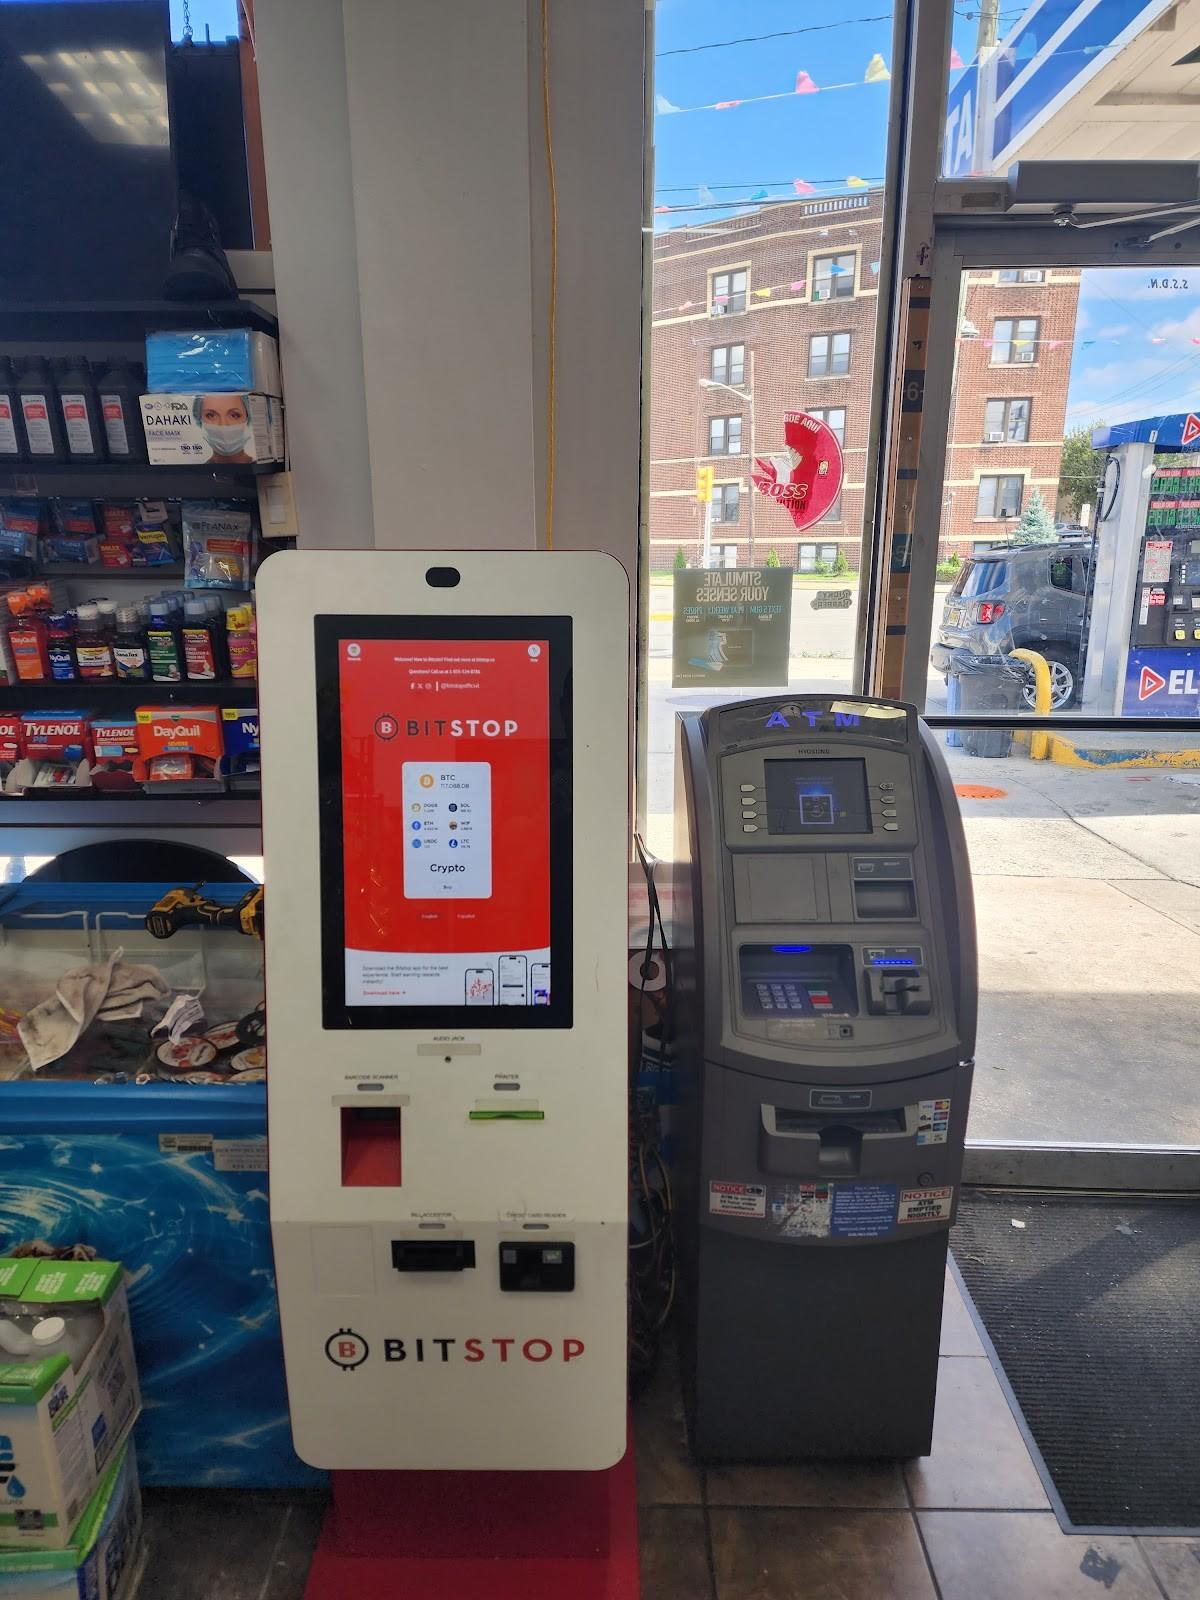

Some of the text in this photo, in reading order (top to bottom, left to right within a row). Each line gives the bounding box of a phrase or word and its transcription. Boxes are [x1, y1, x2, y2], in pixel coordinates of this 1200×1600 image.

[907, 382, 918, 401] 6
[146, 414, 192, 426] DAHAKI
[757, 481, 808, 499] BOSS
[1168, 669, 1198, 695] EL
[766, 710, 860, 728] ATM
[24, 722, 81, 736] TYLENOL
[96, 728, 135, 737] TYLENOL
[153, 725, 200, 739] DayQuil
[407, 719, 519, 737] BITSTOP
[430, 863, 466, 873] Crypto
[712, 1184, 744, 1194] NOTICE
[904, 1190, 950, 1199] NOTICE
[384, 1338, 585, 1363] BITSTOP
